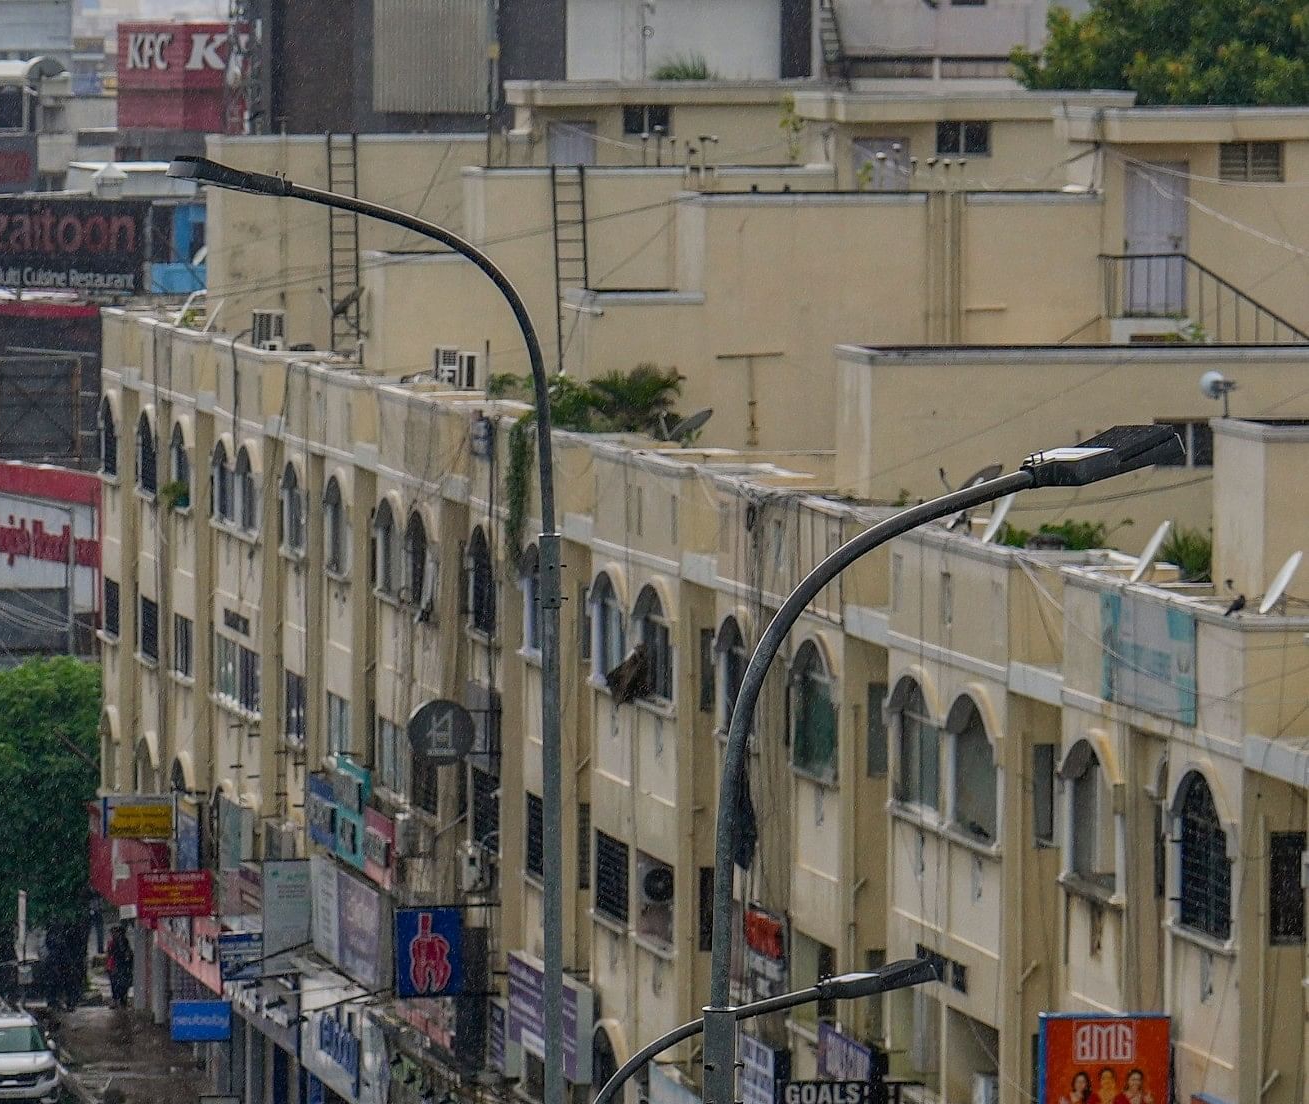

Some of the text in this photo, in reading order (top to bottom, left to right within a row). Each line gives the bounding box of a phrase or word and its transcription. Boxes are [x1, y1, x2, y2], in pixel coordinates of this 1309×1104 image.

[126, 32, 172, 70] KFC
[23, 266, 66, 288] Cuisine
[69, 268, 135, 290] Restaurant
[785, 1083, 861, 1104] GOALS
